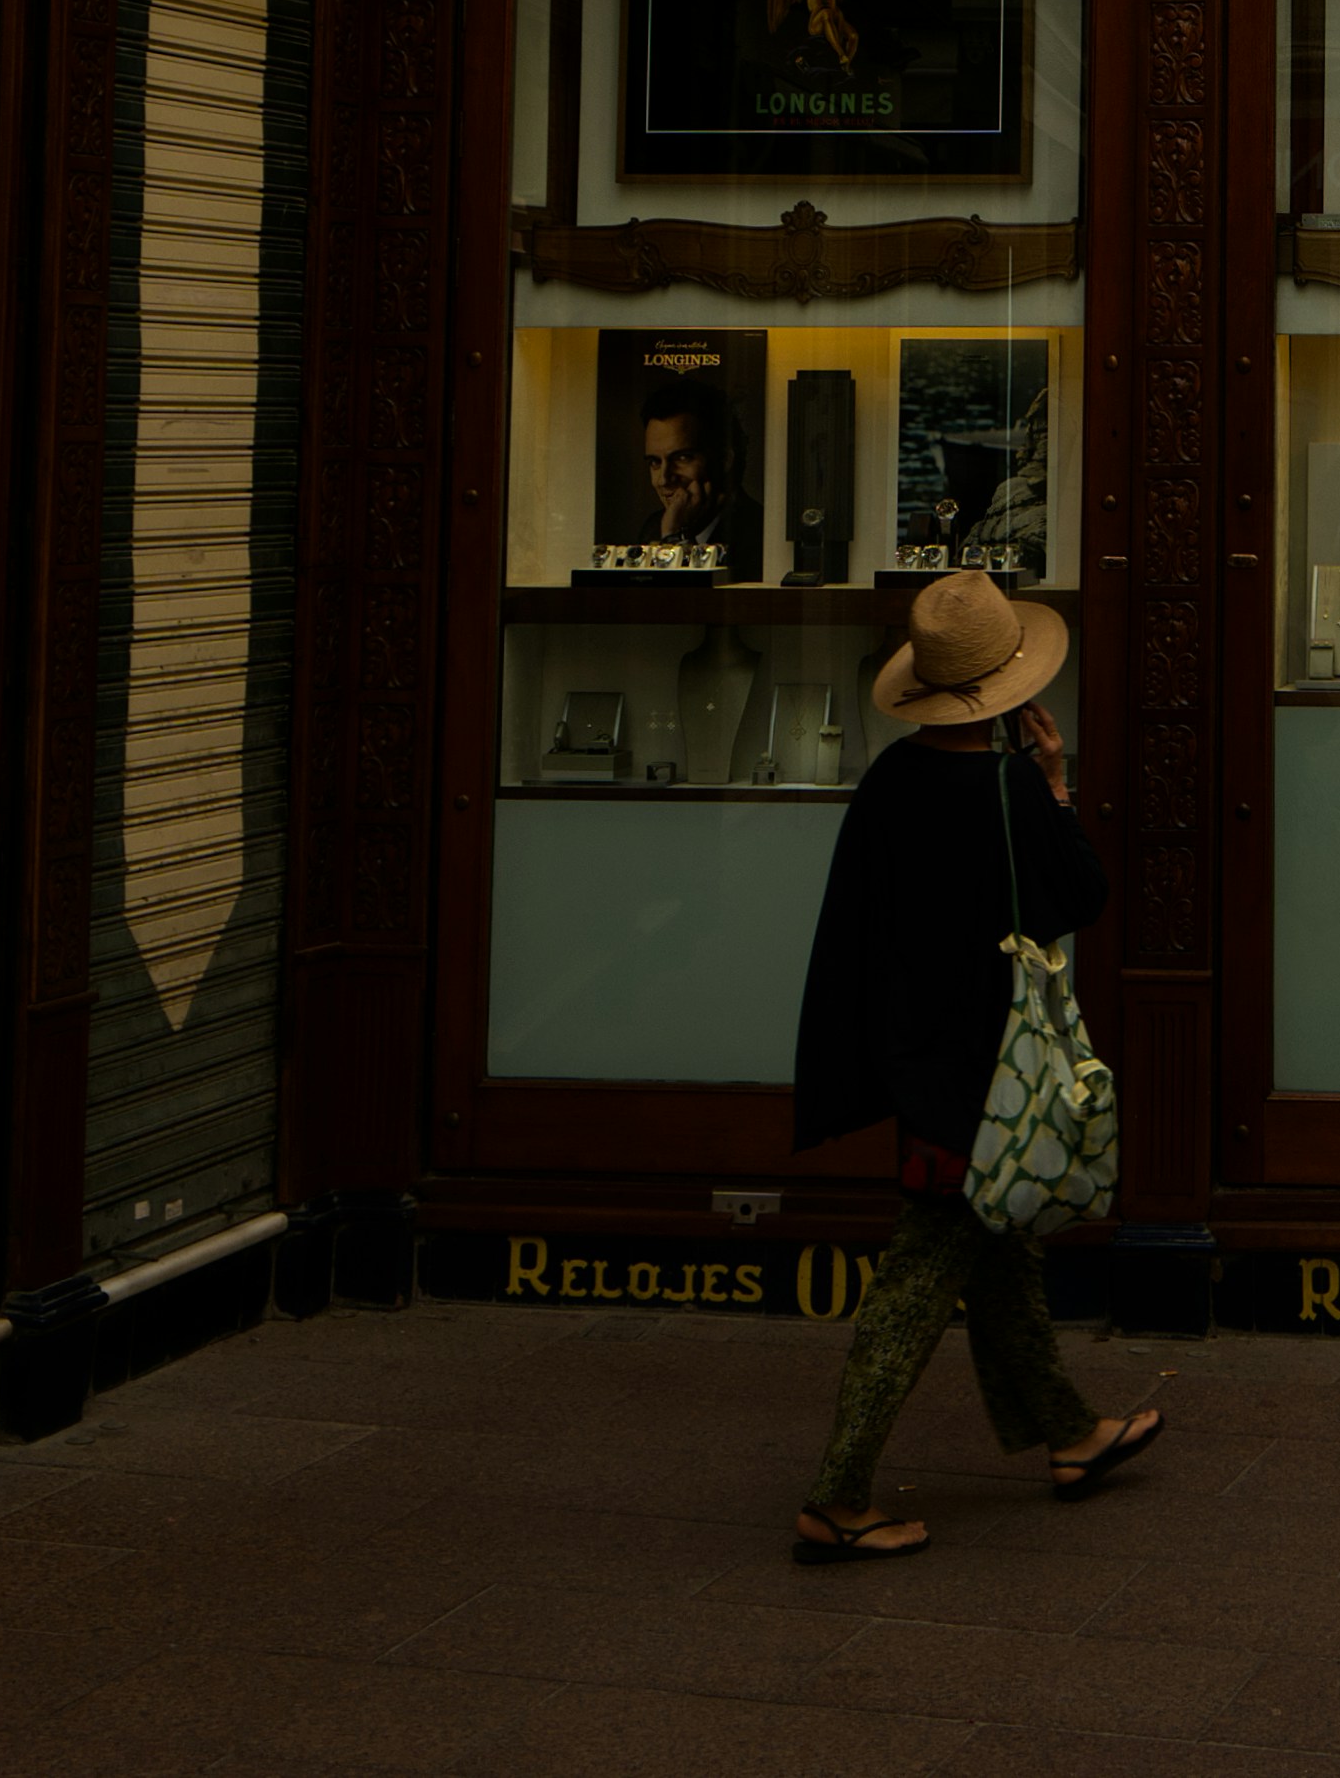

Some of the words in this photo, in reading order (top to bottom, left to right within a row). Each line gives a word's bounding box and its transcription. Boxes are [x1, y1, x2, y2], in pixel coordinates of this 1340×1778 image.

[755, 92, 894, 115] LONGINES
[643, 354, 721, 366] LONGINES
[504, 1236, 763, 1303] RELOJES
